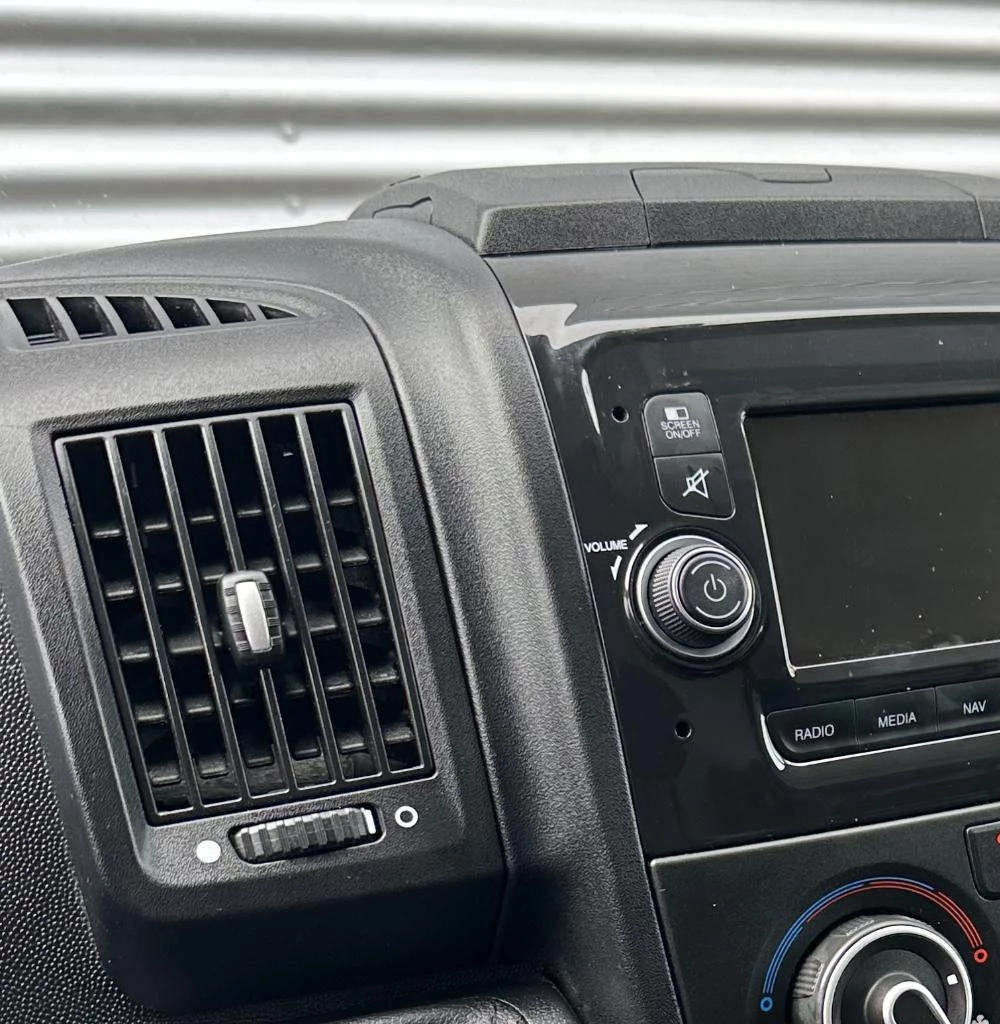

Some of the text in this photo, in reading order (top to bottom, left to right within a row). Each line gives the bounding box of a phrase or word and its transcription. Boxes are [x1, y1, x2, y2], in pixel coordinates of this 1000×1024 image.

[660, 420, 700, 431] SCREEN
[665, 428, 701, 440] ON/OFF
[584, 539, 628, 553] VOLUME
[963, 699, 987, 716] NAV
[877, 711, 917, 729] MEDIA
[794, 723, 835, 742] RADIO
